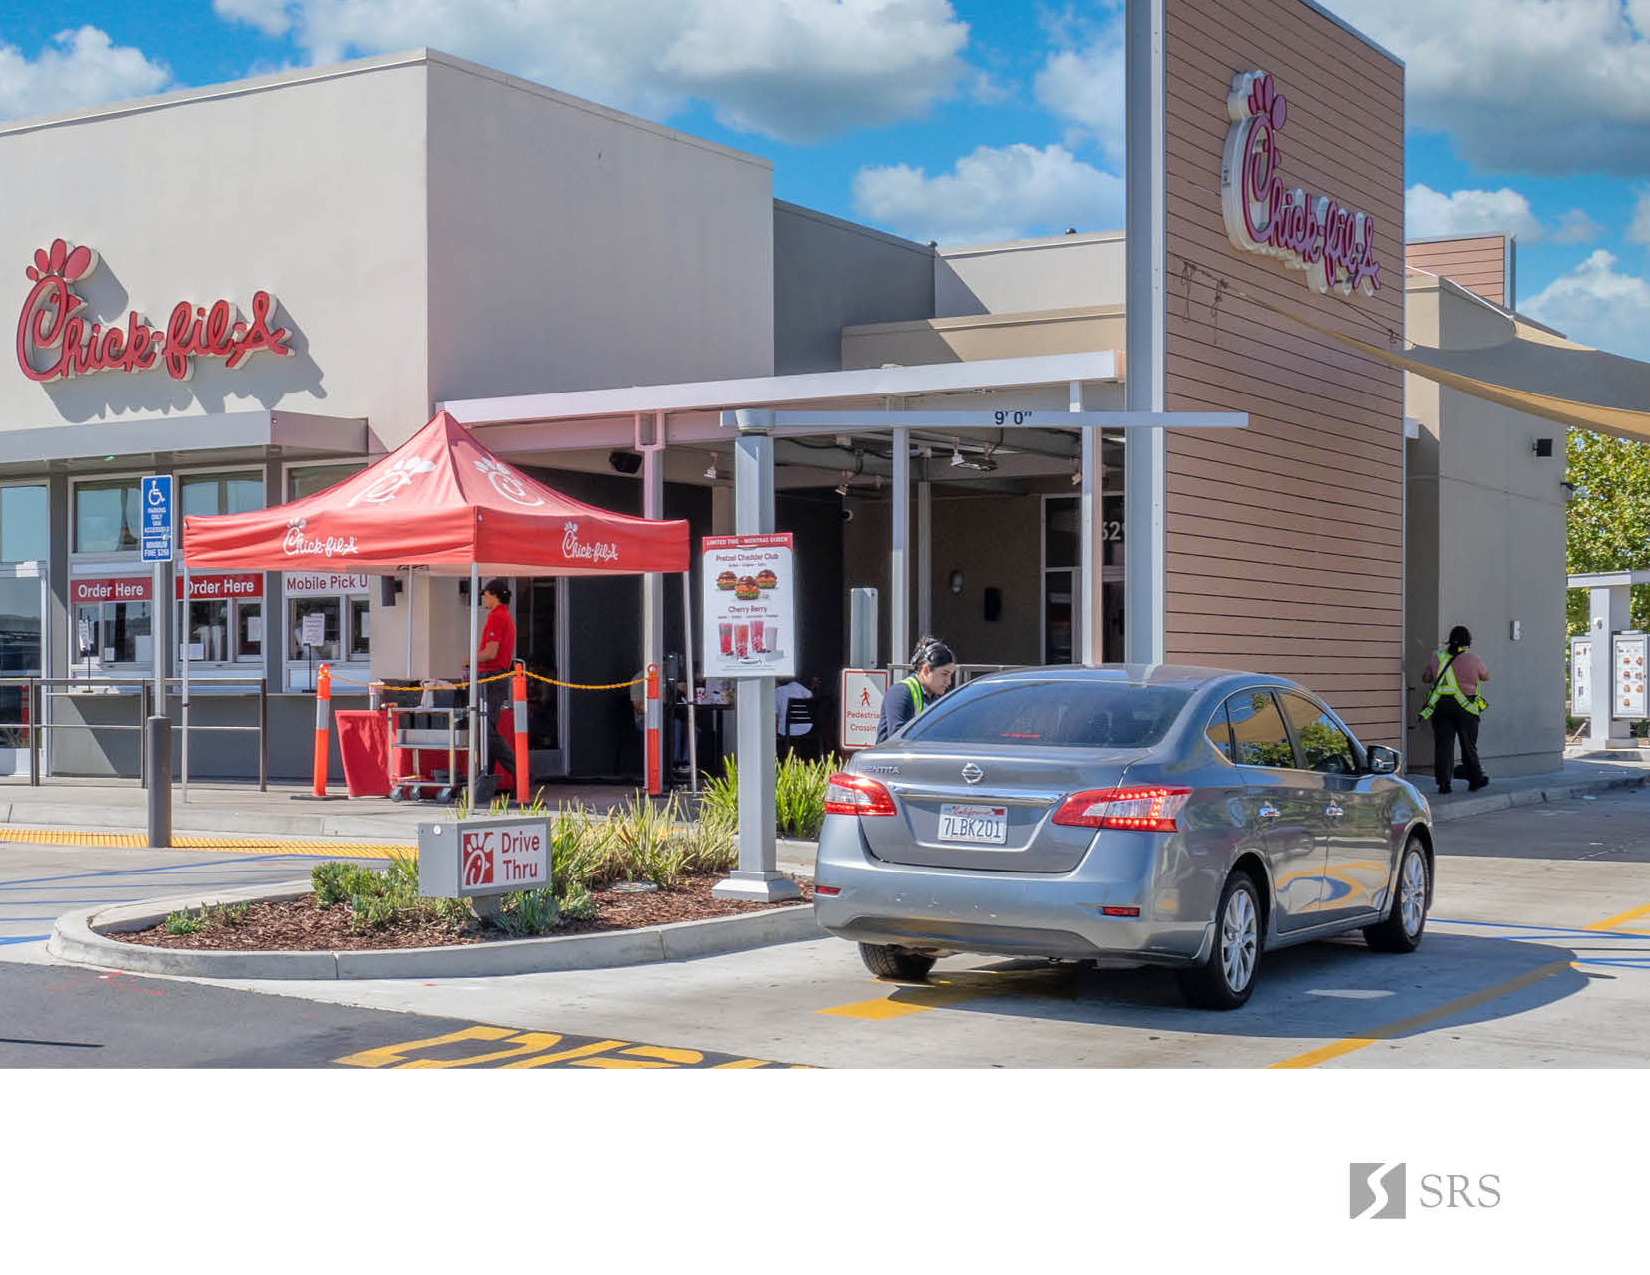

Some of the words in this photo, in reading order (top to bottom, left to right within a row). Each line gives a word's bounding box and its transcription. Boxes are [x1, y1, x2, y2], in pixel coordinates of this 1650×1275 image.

[1242, 75, 1381, 290] Chick-fil-A
[16, 238, 289, 382] Chick-fil-A
[994, 410, 1009, 425] 9'
[283, 518, 358, 557] Chick-fil-A
[562, 521, 618, 563] Chick-fil-A
[78, 583, 112, 598] Order
[116, 583, 144, 597] Here
[223, 579, 254, 593] Here
[286, 577, 327, 590] Mobile
[329, 575, 356, 588] Pick
[359, 574, 368, 587] U
[728, 606, 749, 614] Cherry
[847, 710, 880, 719] Pedestria
[850, 724, 876, 732] Crossin
[944, 817, 1001, 838] 7LBK201
[502, 830, 540, 853] Drive
[502, 859, 538, 880] Thru
